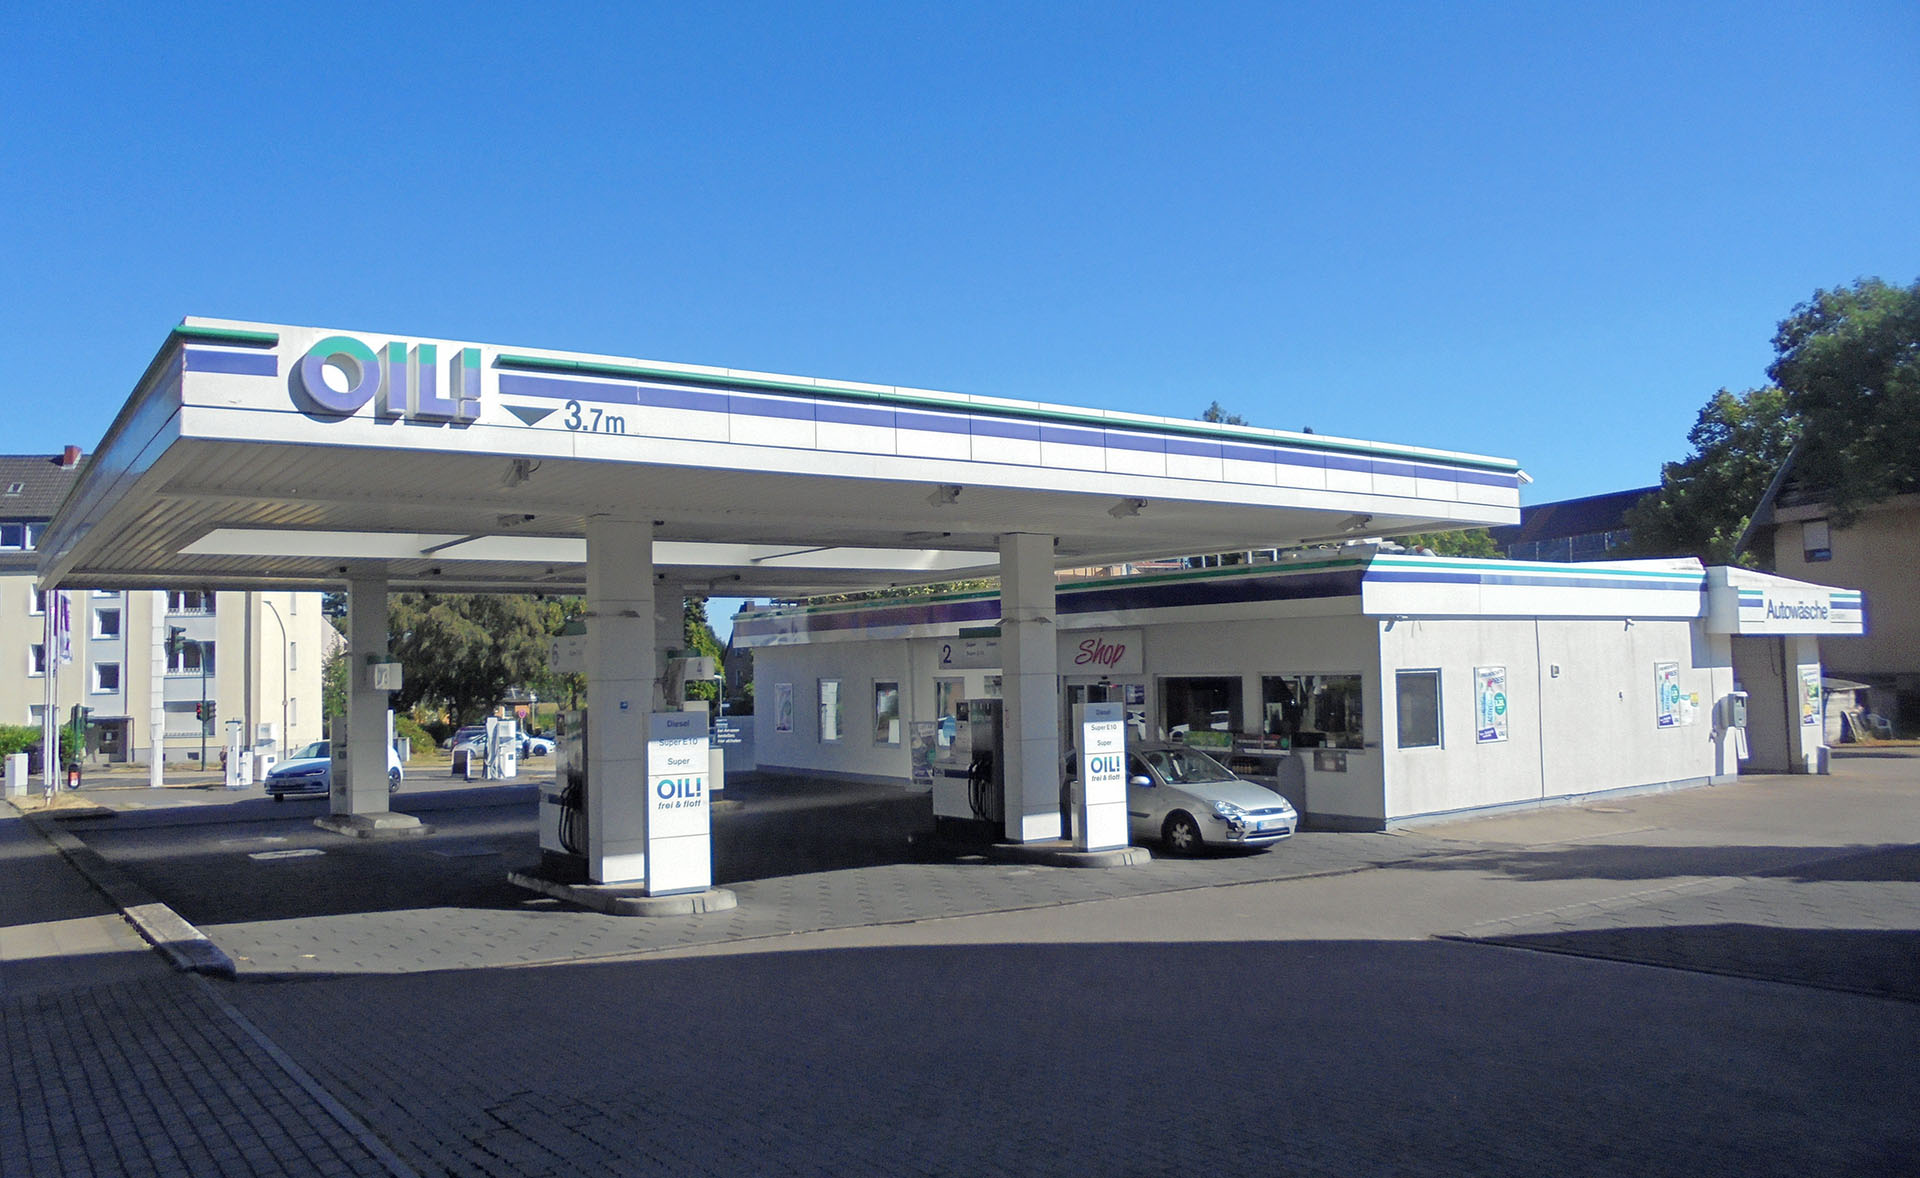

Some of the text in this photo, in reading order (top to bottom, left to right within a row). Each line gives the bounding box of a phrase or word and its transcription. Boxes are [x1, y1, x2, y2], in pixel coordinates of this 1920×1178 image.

[298, 335, 482, 421] OIL!
[564, 400, 626, 433] 3.7m
[1766, 599, 1828, 620] Autowäsche
[943, 644, 952, 664] 2
[1074, 638, 1126, 669] Shop
[667, 720, 690, 728] Diesel
[1091, 724, 1106, 732] Super
[659, 737, 698, 748] Super E10
[1097, 739, 1112, 747] Super
[667, 757, 690, 766] Super
[1091, 756, 1120, 774] OIL!
[657, 777, 702, 800] OIL!
[658, 801, 674, 810] frei
[683, 799, 702, 808] flott
